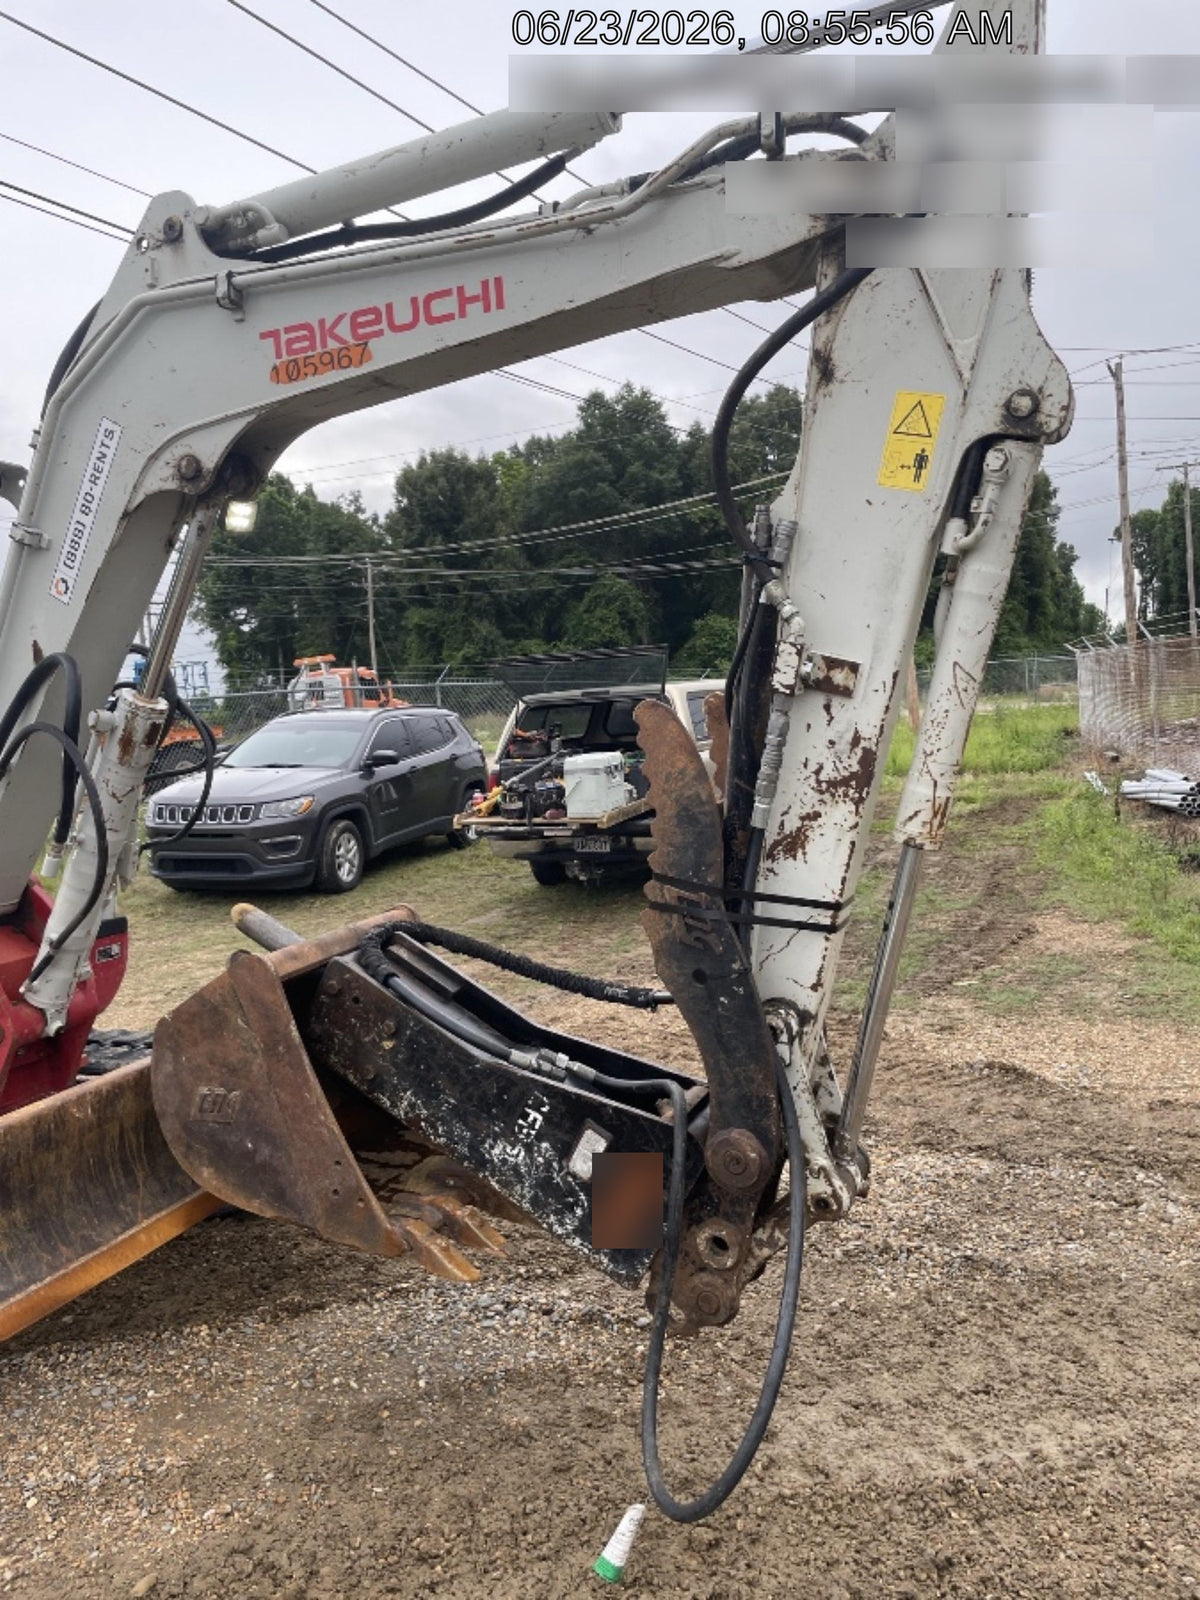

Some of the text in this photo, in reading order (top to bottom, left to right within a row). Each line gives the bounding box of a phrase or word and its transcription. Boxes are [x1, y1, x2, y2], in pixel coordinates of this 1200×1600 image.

[271, 342, 369, 384] 105967
[63, 427, 116, 570] (888) 80-RENTS
